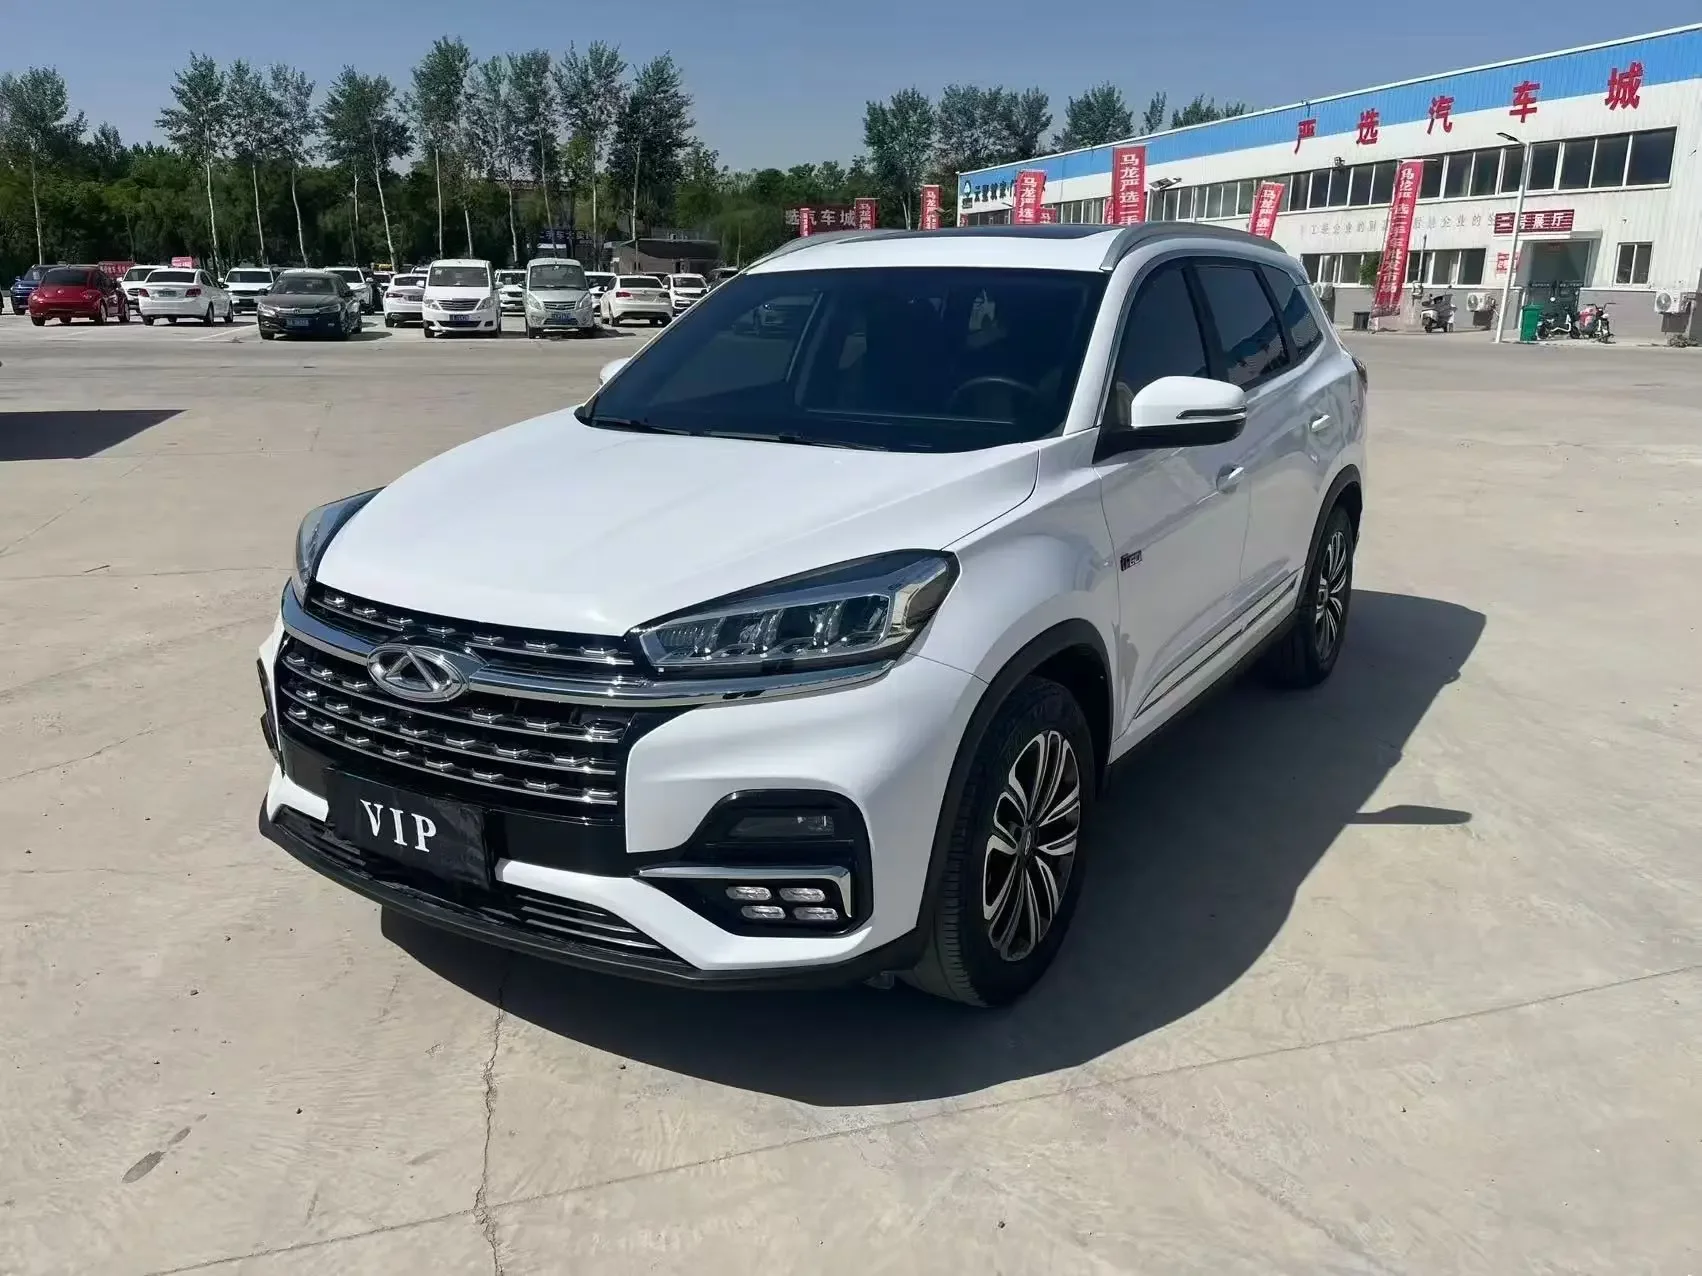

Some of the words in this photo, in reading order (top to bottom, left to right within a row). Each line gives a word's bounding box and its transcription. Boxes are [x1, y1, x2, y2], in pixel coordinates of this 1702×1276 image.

[1293, 62, 1643, 153] 严选汽车城
[1119, 153, 1141, 226] 马龙严选二手
[360, 798, 437, 853] VIP
